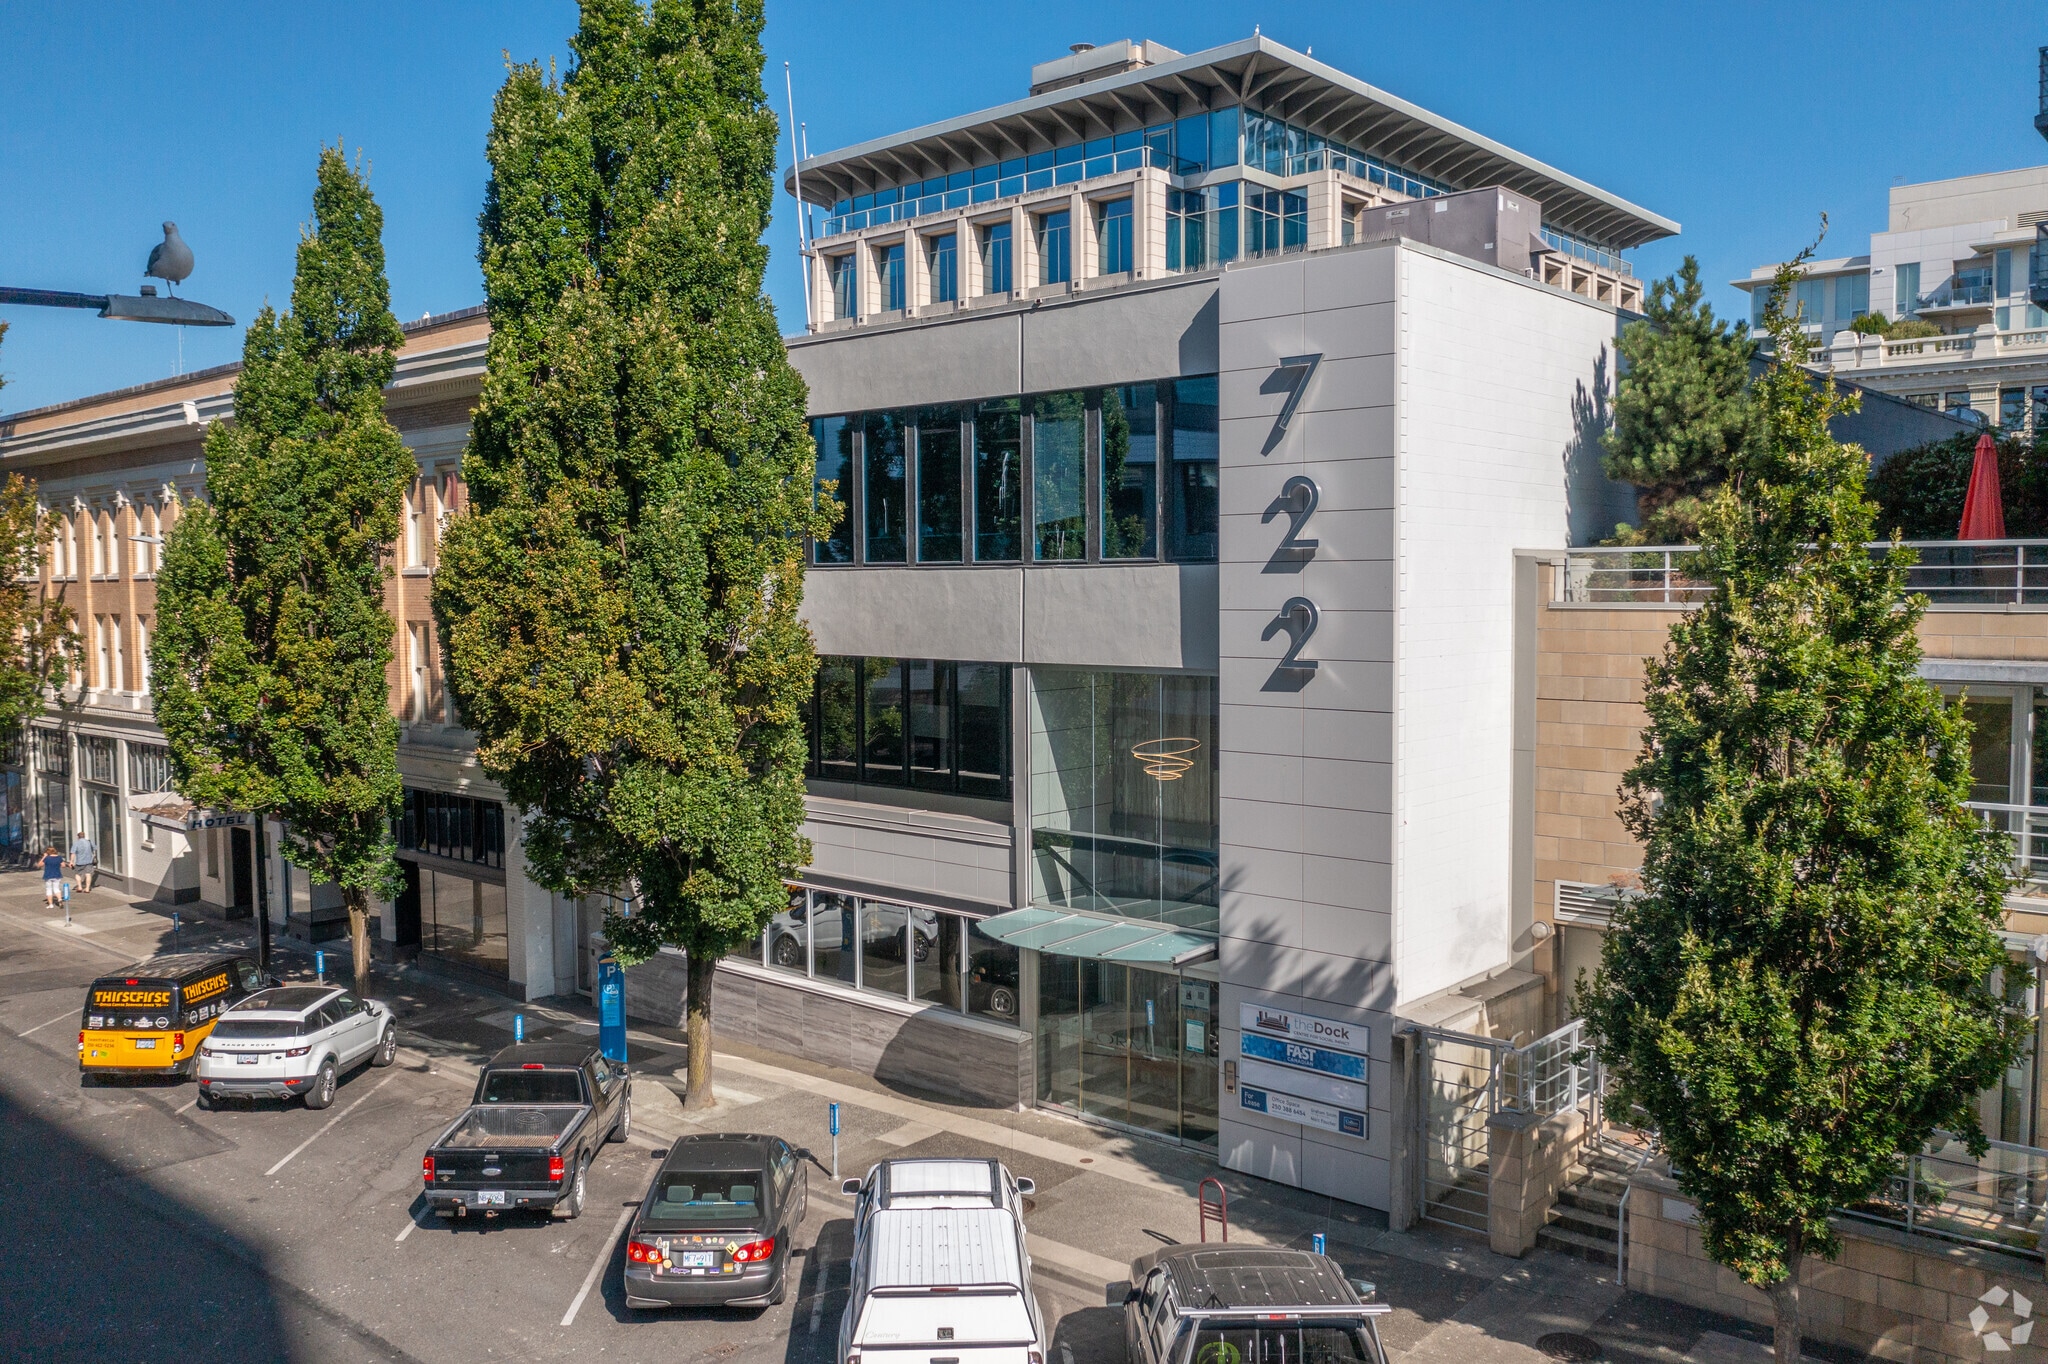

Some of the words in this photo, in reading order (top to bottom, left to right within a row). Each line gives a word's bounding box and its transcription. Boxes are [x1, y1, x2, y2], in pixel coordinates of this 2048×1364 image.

[192, 815, 245, 828] HOTEL
[1294, 1017, 1350, 1040] theDock
[1319, 1035, 1334, 1043] SOCIAL
[1286, 1043, 1317, 1062] FAST
[1286, 1056, 1314, 1067] CANADIAN
[1244, 1091, 1254, 1099] For
[1244, 1099, 1261, 1108] Lease
[1271, 1096, 1285, 1104] Office
[1286, 1100, 1300, 1108] Space
[1271, 1103, 1282, 1111] 250
